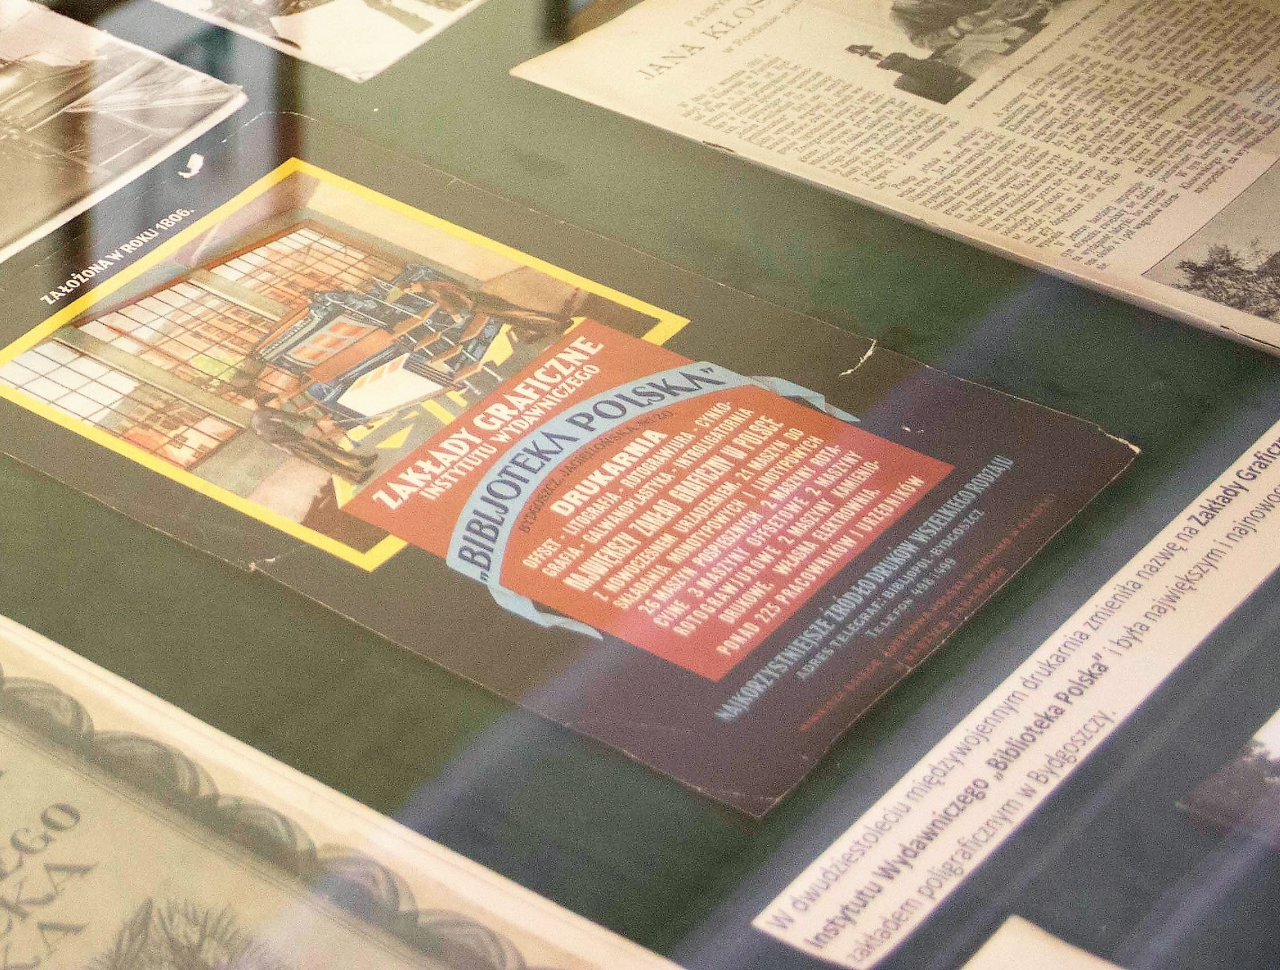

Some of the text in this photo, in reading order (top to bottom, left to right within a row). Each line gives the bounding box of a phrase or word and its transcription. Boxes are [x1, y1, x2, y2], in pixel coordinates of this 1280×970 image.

[637, 43, 706, 79] JANA
[39, 208, 196, 305] ZAŁOŻONA W ROKU 1806.
[372, 336, 604, 510] ZAKŁADY GRAFICZNE
[419, 364, 600, 500] INSTYTUTU WYDAWNICZEGO
[457, 366, 727, 582] „BIBLJOTEKA POLSKA”
[522, 401, 732, 569] OFFSET LITOGRAFJA ROTOGRAWJURA CYNKO-
[542, 407, 755, 577] GRAFJA GALWANOPLASTYKA INTROLIGATORNIA
[550, 429, 668, 517] DRUKARNIA
[563, 415, 784, 592] NAJWIĘKSZY ZAKŁAD GRAFICZNY W POLSCE
[603, 533, 678, 593] NOWOCZESNEM
[735, 468, 755, 481] 21
[747, 439, 790, 471] MASZYN
[783, 427, 804, 441] DO
[613, 564, 672, 610] SKŁADANIA
[666, 498, 748, 564] MONOTYPOWYCH
[751, 435, 824, 492] LINOTYPOWYCH
[637, 599, 661, 615] 26
[652, 566, 698, 602] MASZYN
[692, 510, 764, 567] POSPIESZNYCH
[769, 465, 816, 502] MASZYNY
[809, 444, 841, 467] ROTA-
[653, 599, 690, 627] CYJNE
[696, 547, 750, 589] MASZYNY
[745, 496, 810, 547] OFFSETOWE
[813, 450, 863, 488] MASZYNY
[672, 545, 782, 637] ROTOGRAWJUROWE
[786, 498, 835, 537] MASZYNY
[830, 460, 880, 499] KAMIENIO-
[716, 622, 760, 656] PONAD
[753, 602, 781, 624] 225
[774, 534, 857, 605] PRACOWNIKÓW
[855, 475, 925, 532] URZĘDNIKÓW
[772, 540, 819, 575] WŁASNA
[1135, 542, 1188, 581] nazwę
[1175, 526, 1201, 543] na
[1187, 480, 1250, 527] Zakłady
[714, 618, 836, 721] NAJKORZYSTNIEJSZE
[823, 578, 877, 622] ŹRÓDŁO
[864, 540, 920, 583] DRUKÓW
[908, 490, 977, 543] WSZELKIEGO
[964, 454, 1014, 494] RODZAJU
[1019, 630, 1091, 691] drukarnia
[1083, 579, 1144, 632] zmieniła
[796, 647, 835, 680] ADRES
[804, 881, 884, 950] Instytutu
[873, 778, 990, 881] Wydawniczego
[985, 704, 1066, 781] „Biblioteka
[1109, 621, 1151, 650] była
[1143, 547, 1227, 622] największym
[905, 690, 1030, 803] międzywojennym
[791, 801, 913, 913] dwudziestoleciu
[846, 709, 1116, 964] zakładem poligraficznym w Bydgoszczy.
[767, 911, 795, 930] W
